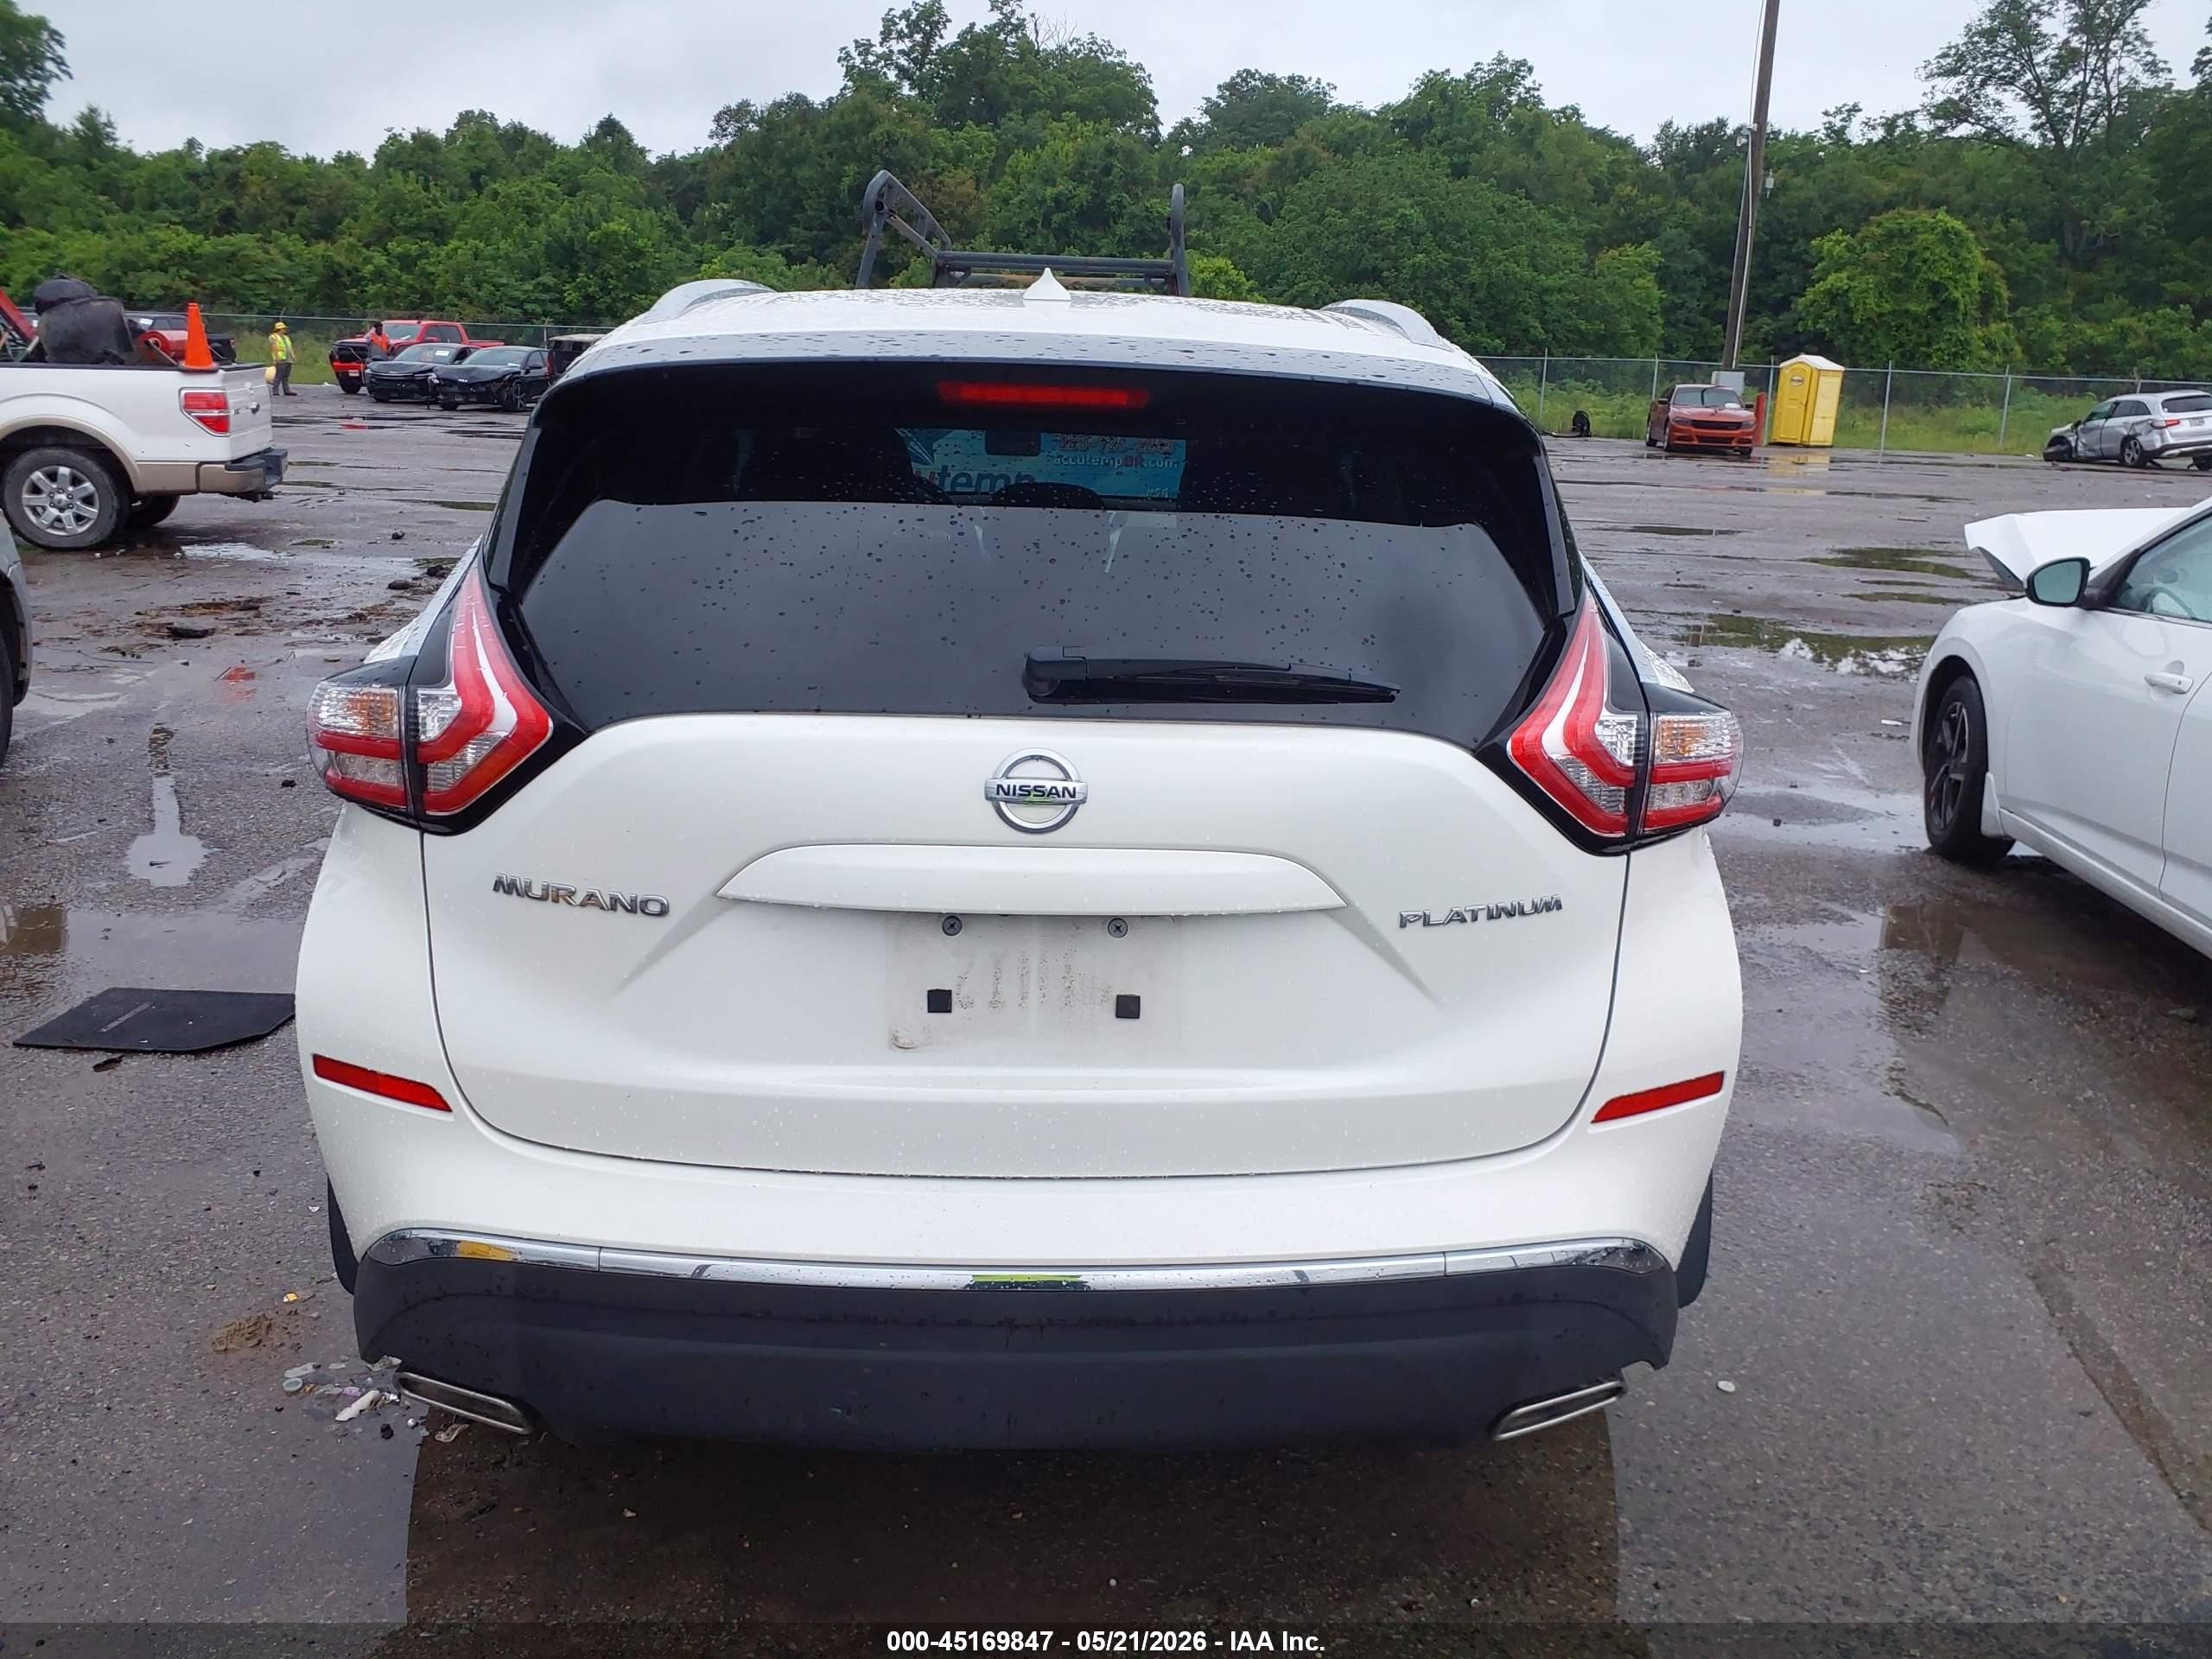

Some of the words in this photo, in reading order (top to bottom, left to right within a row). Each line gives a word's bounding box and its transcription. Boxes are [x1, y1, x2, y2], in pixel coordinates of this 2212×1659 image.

[995, 783, 1077, 798] NISSAN
[493, 872, 670, 918] MURANO
[1399, 893, 1563, 929] PLATINUM
